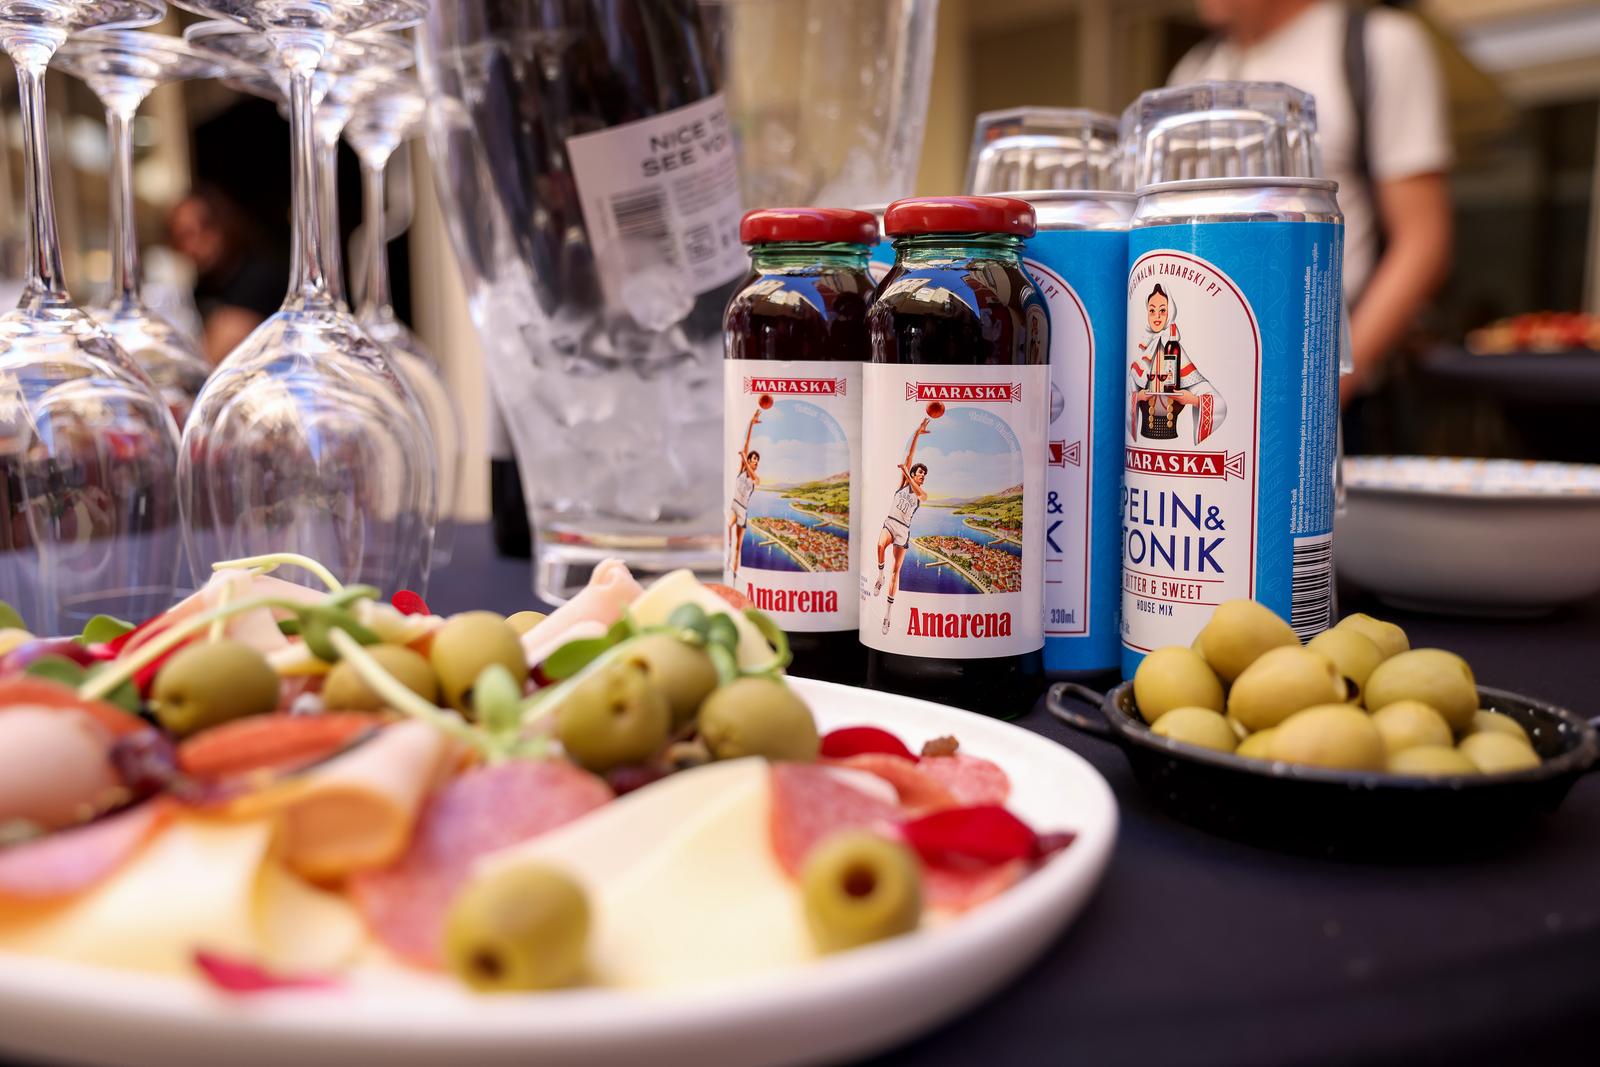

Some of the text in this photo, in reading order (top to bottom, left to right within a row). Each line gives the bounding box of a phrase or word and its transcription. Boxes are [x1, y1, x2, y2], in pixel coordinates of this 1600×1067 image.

[649, 119, 706, 153] NICE
[641, 146, 697, 178] SEE
[1044, 284, 1059, 299] PT
[1159, 263, 1205, 287] ZADARSKI
[1206, 282, 1222, 297] PT
[754, 380, 832, 393] MARASKA
[921, 386, 1007, 400] MARASKA
[1125, 450, 1217, 474] MARASKA
[1122, 526, 1226, 574] TONIK
[746, 582, 838, 613] Amarena
[1125, 572, 1203, 600] BITTER & SWEET
[1050, 608, 1076, 624] 330mL
[1137, 599, 1174, 616] HOUSE MIX
[906, 606, 1012, 639] Amarena
